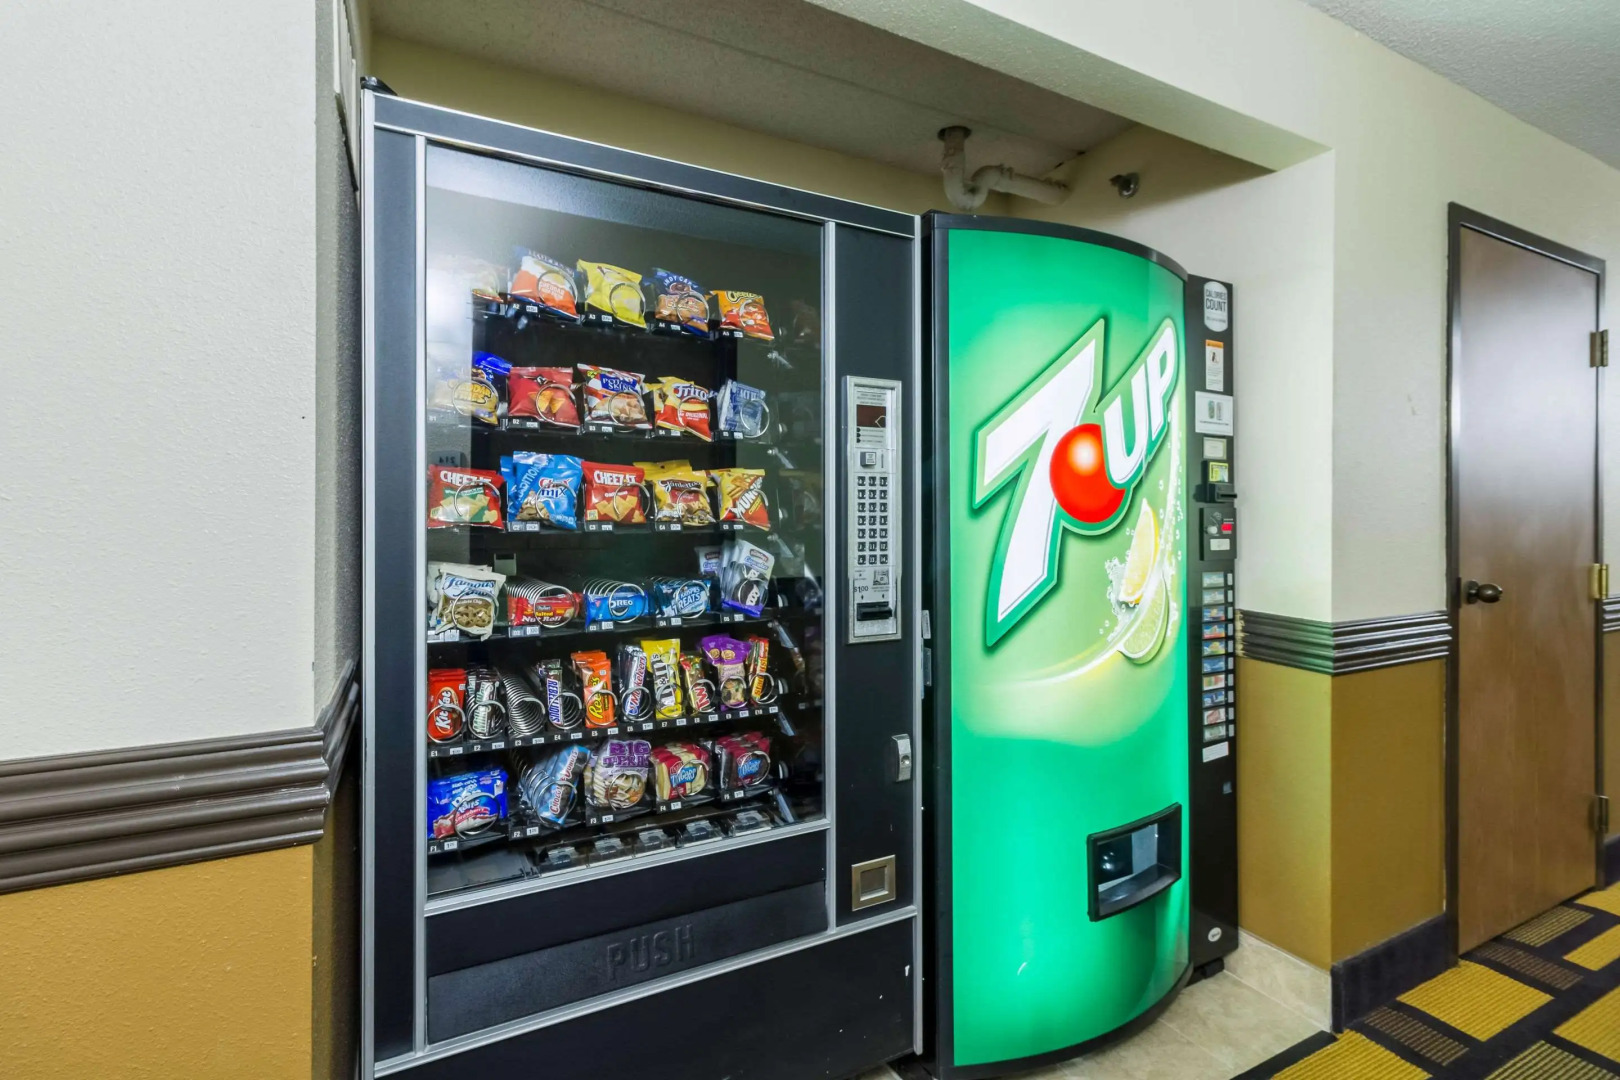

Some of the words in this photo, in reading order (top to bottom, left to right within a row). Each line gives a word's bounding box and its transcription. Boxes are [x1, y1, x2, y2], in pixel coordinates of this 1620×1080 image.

[1206, 289, 1227, 301] CALORIES
[1206, 298, 1227, 312] COUNT
[593, 470, 637, 486] CHEEZ-IT
[540, 486, 568, 498] mix
[442, 574, 496, 591] Famous
[610, 600, 634, 609] OREO
[542, 615, 562, 623] Roll
[630, 655, 647, 707] Muketeers
[609, 742, 651, 756] BIG
[564, 747, 579, 780] DONUTS
[602, 755, 652, 768] TEXAS
[607, 924, 697, 982] PUSH
